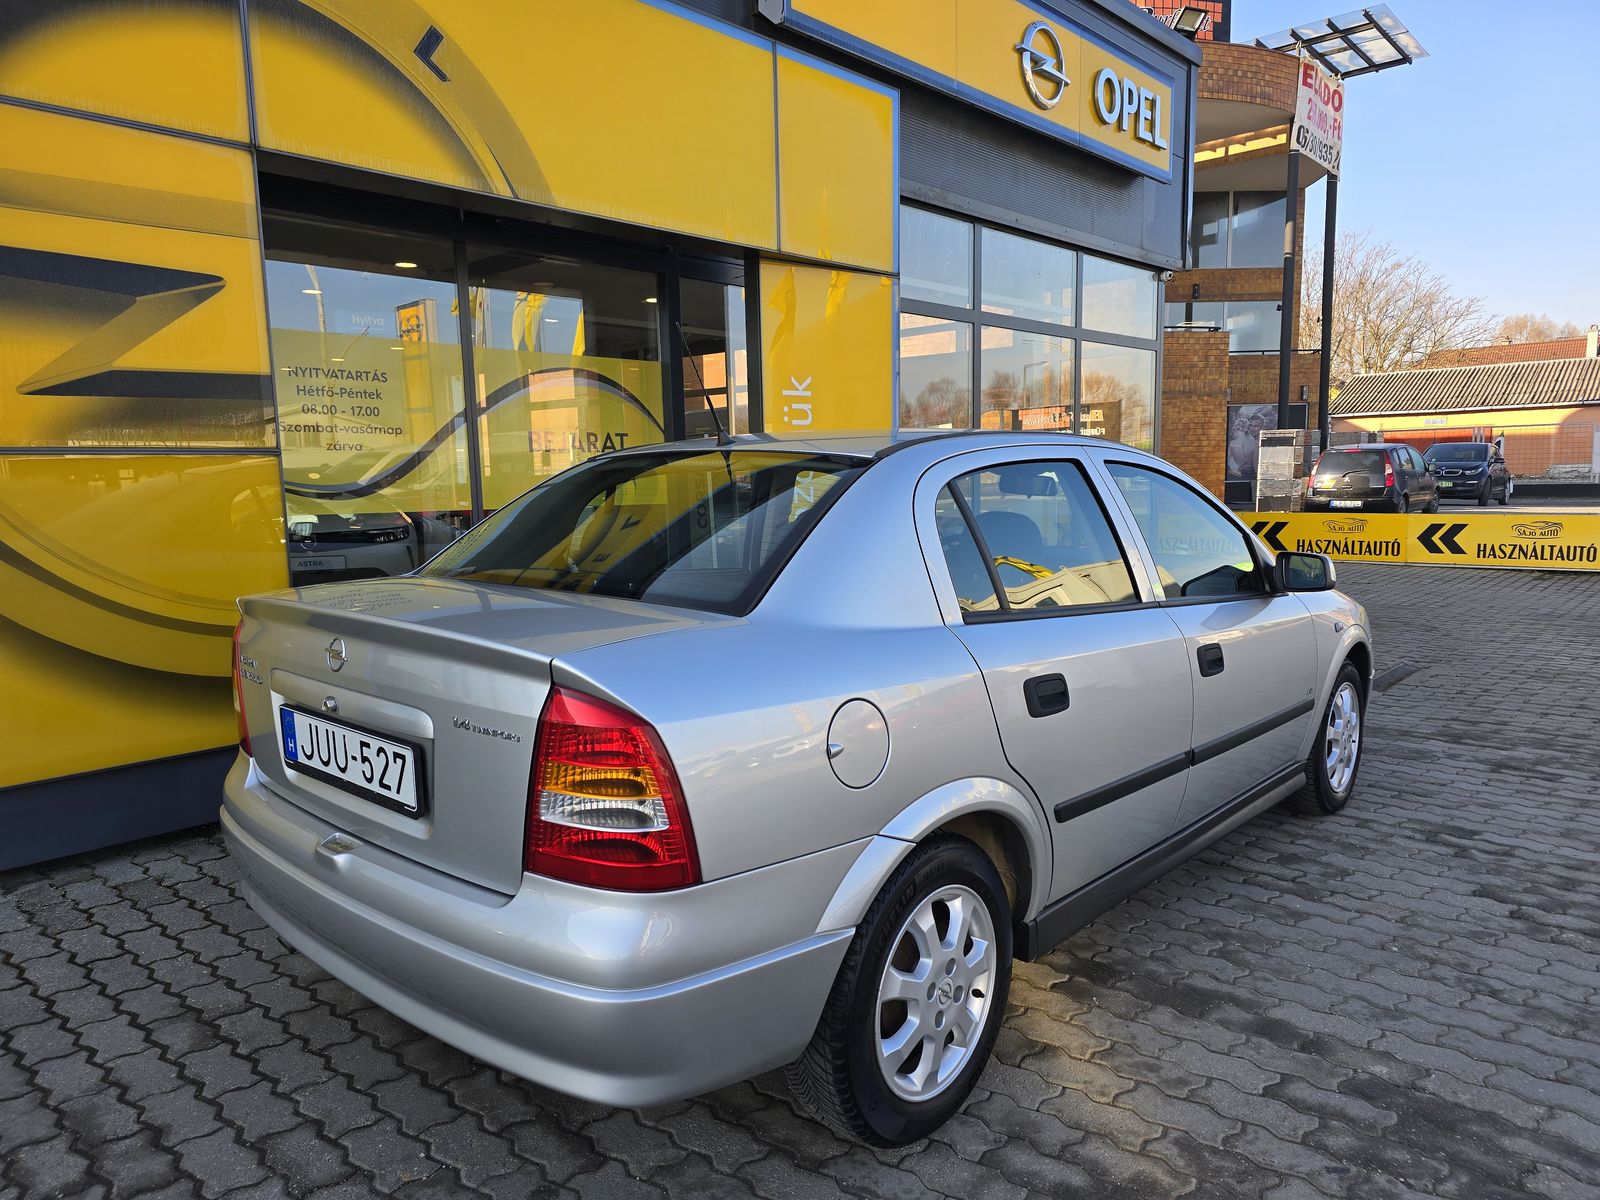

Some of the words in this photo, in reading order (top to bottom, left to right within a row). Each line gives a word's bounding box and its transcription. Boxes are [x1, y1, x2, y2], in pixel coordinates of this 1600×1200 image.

[1302, 62, 1343, 113] ELADÓ
[1095, 67, 1168, 150] OPEL
[288, 366, 388, 383] NYITVATARTÁS
[296, 385, 383, 400] Hétfő-Péntek
[302, 404, 337, 415] 08.00
[350, 405, 380, 417] 17.00
[782, 375, 812, 432] ük
[279, 421, 403, 437] Szombat-vasárnap
[326, 441, 363, 451] zárva
[1296, 537, 1401, 557] HASZNÁLTAUTÓ
[1476, 541, 1598, 563] HASZNÁLTAUTÓ
[297, 560, 324, 568] ASTRA
[287, 738, 295, 753] H
[301, 722, 406, 795] JUU-527
